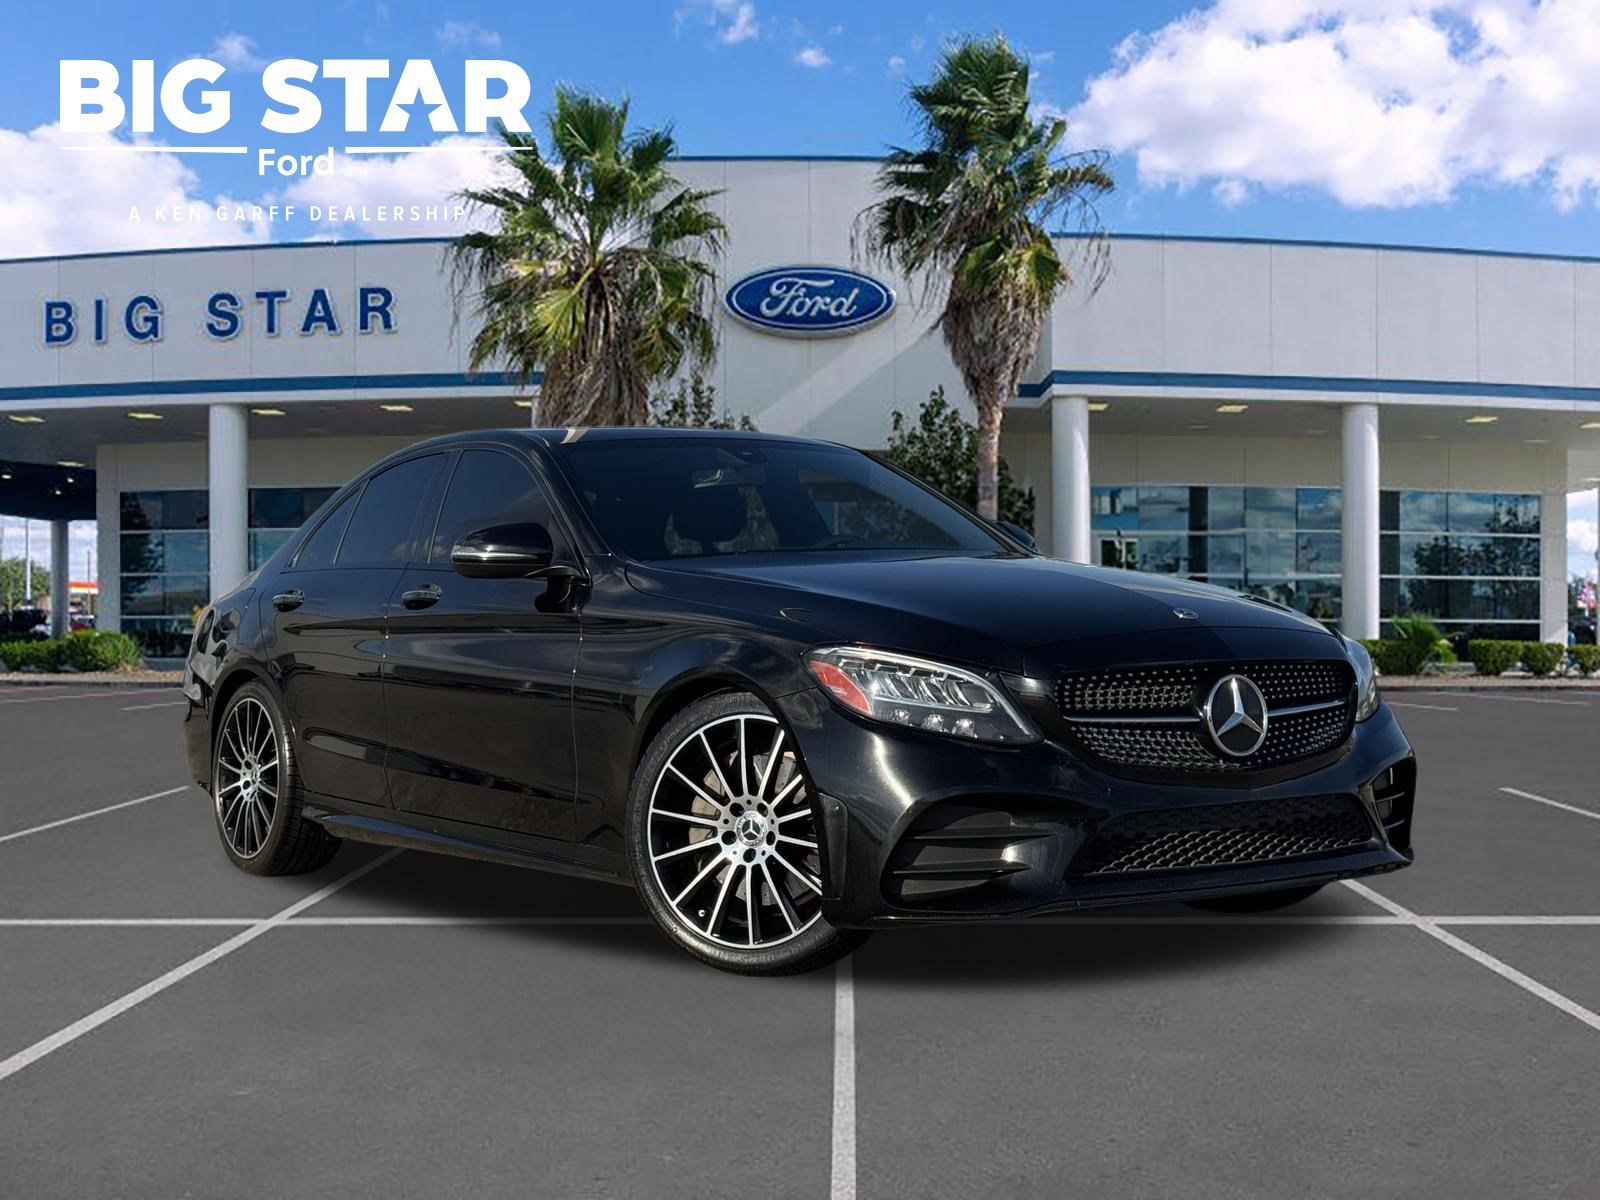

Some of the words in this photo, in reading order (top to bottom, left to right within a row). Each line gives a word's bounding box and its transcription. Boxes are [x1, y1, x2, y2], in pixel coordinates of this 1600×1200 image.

[44, 295, 162, 345] BIG
[206, 286, 397, 341] STAR
[760, 277, 860, 318] Ford
